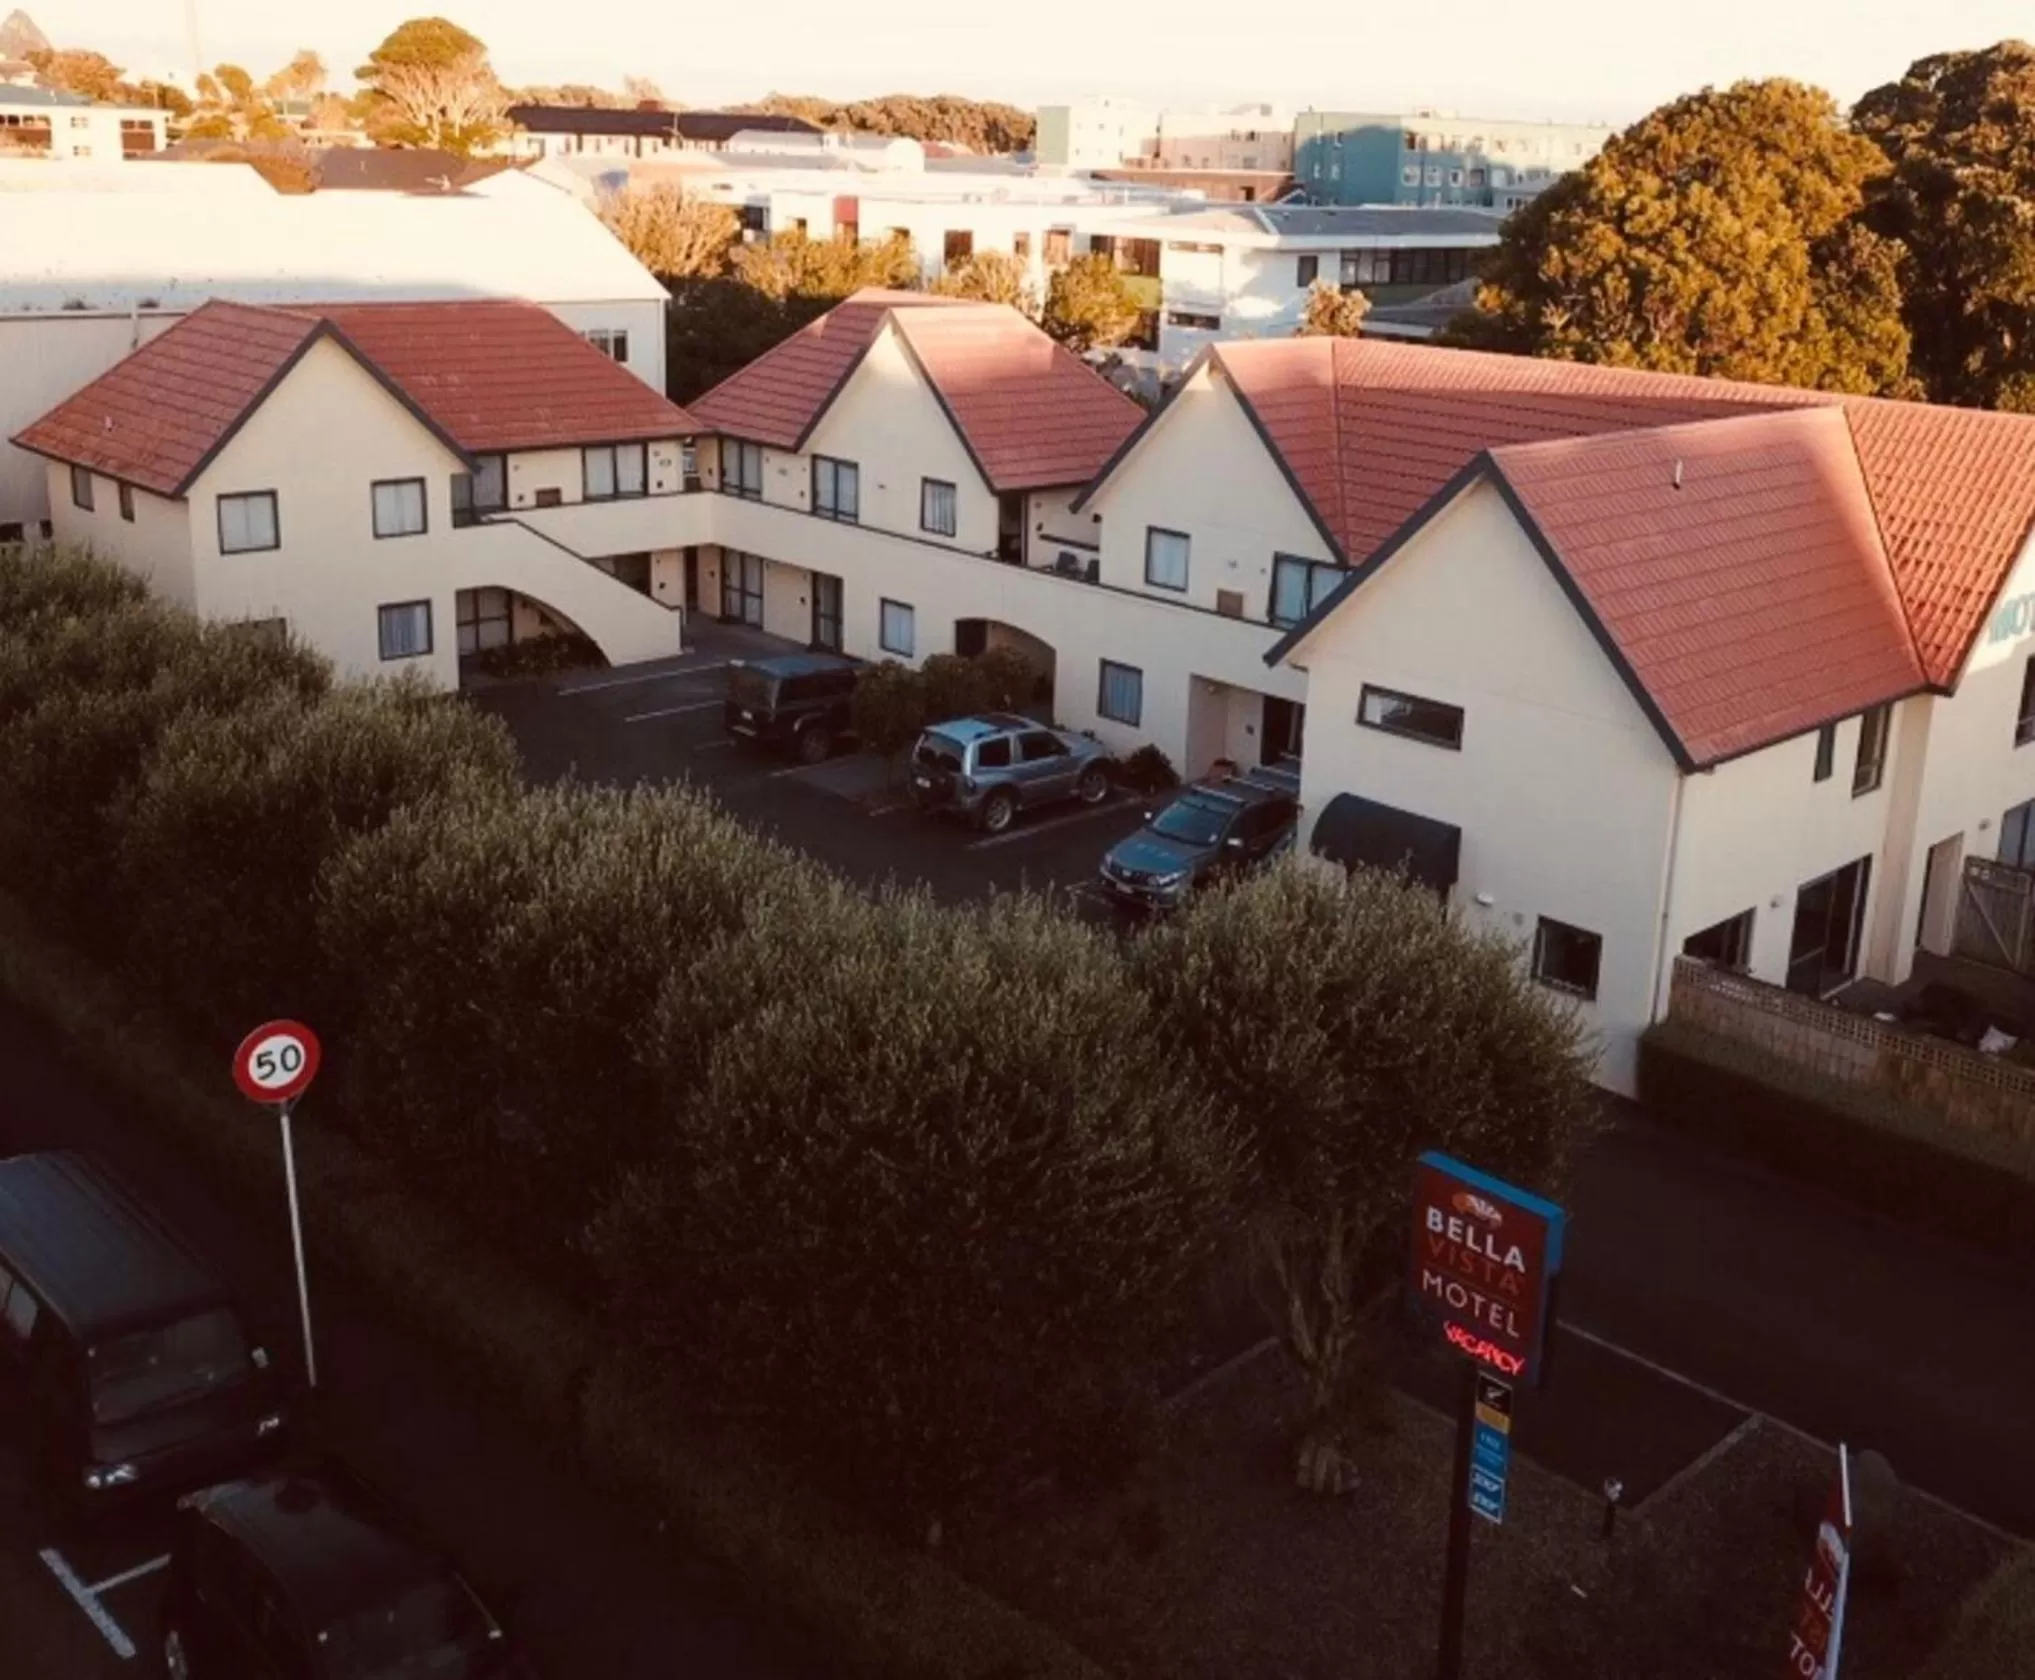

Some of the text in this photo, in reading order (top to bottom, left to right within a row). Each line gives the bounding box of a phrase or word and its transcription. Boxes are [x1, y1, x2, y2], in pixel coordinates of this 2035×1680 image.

[256, 1044, 302, 1081] 50
[1425, 1205, 1526, 1274] BELLA
[1427, 1233, 1520, 1296] VISTA
[1422, 1269, 1520, 1338] MOTEL
[1443, 1319, 1526, 1376] VACANCY
